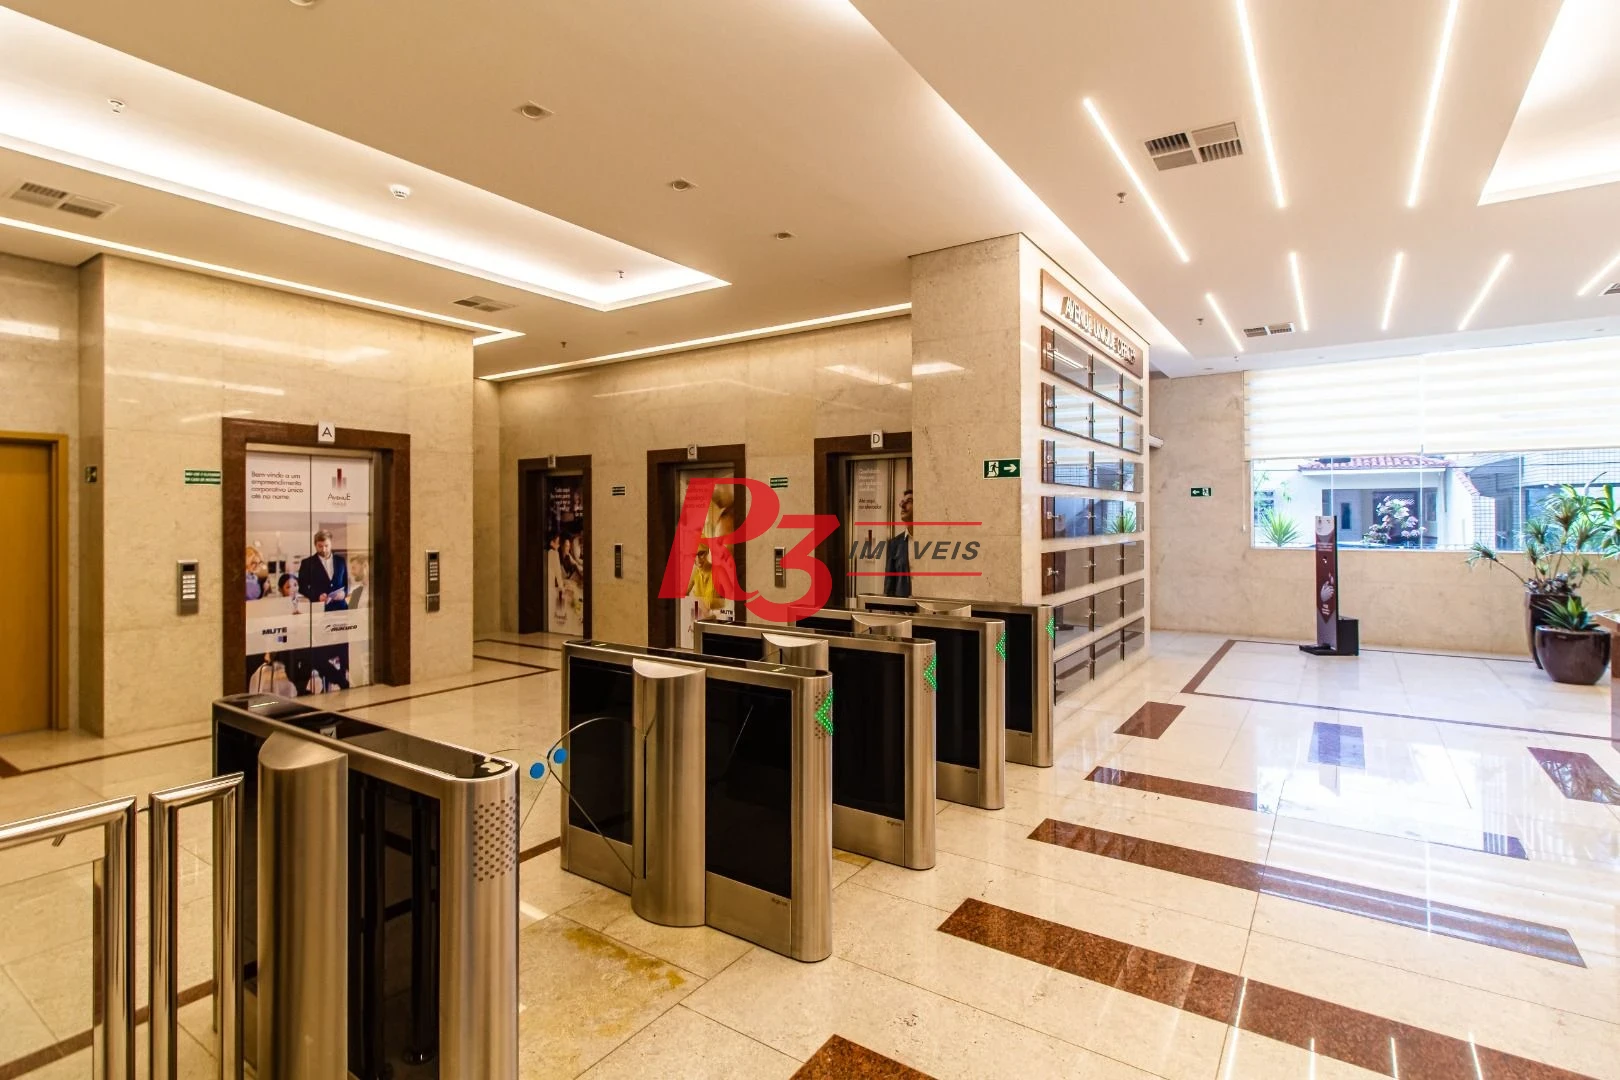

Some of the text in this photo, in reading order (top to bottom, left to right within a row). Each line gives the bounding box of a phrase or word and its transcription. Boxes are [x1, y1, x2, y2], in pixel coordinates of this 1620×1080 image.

[322, 427, 332, 437] A
[873, 434, 880, 443] D
[262, 627, 288, 635] MUTE
